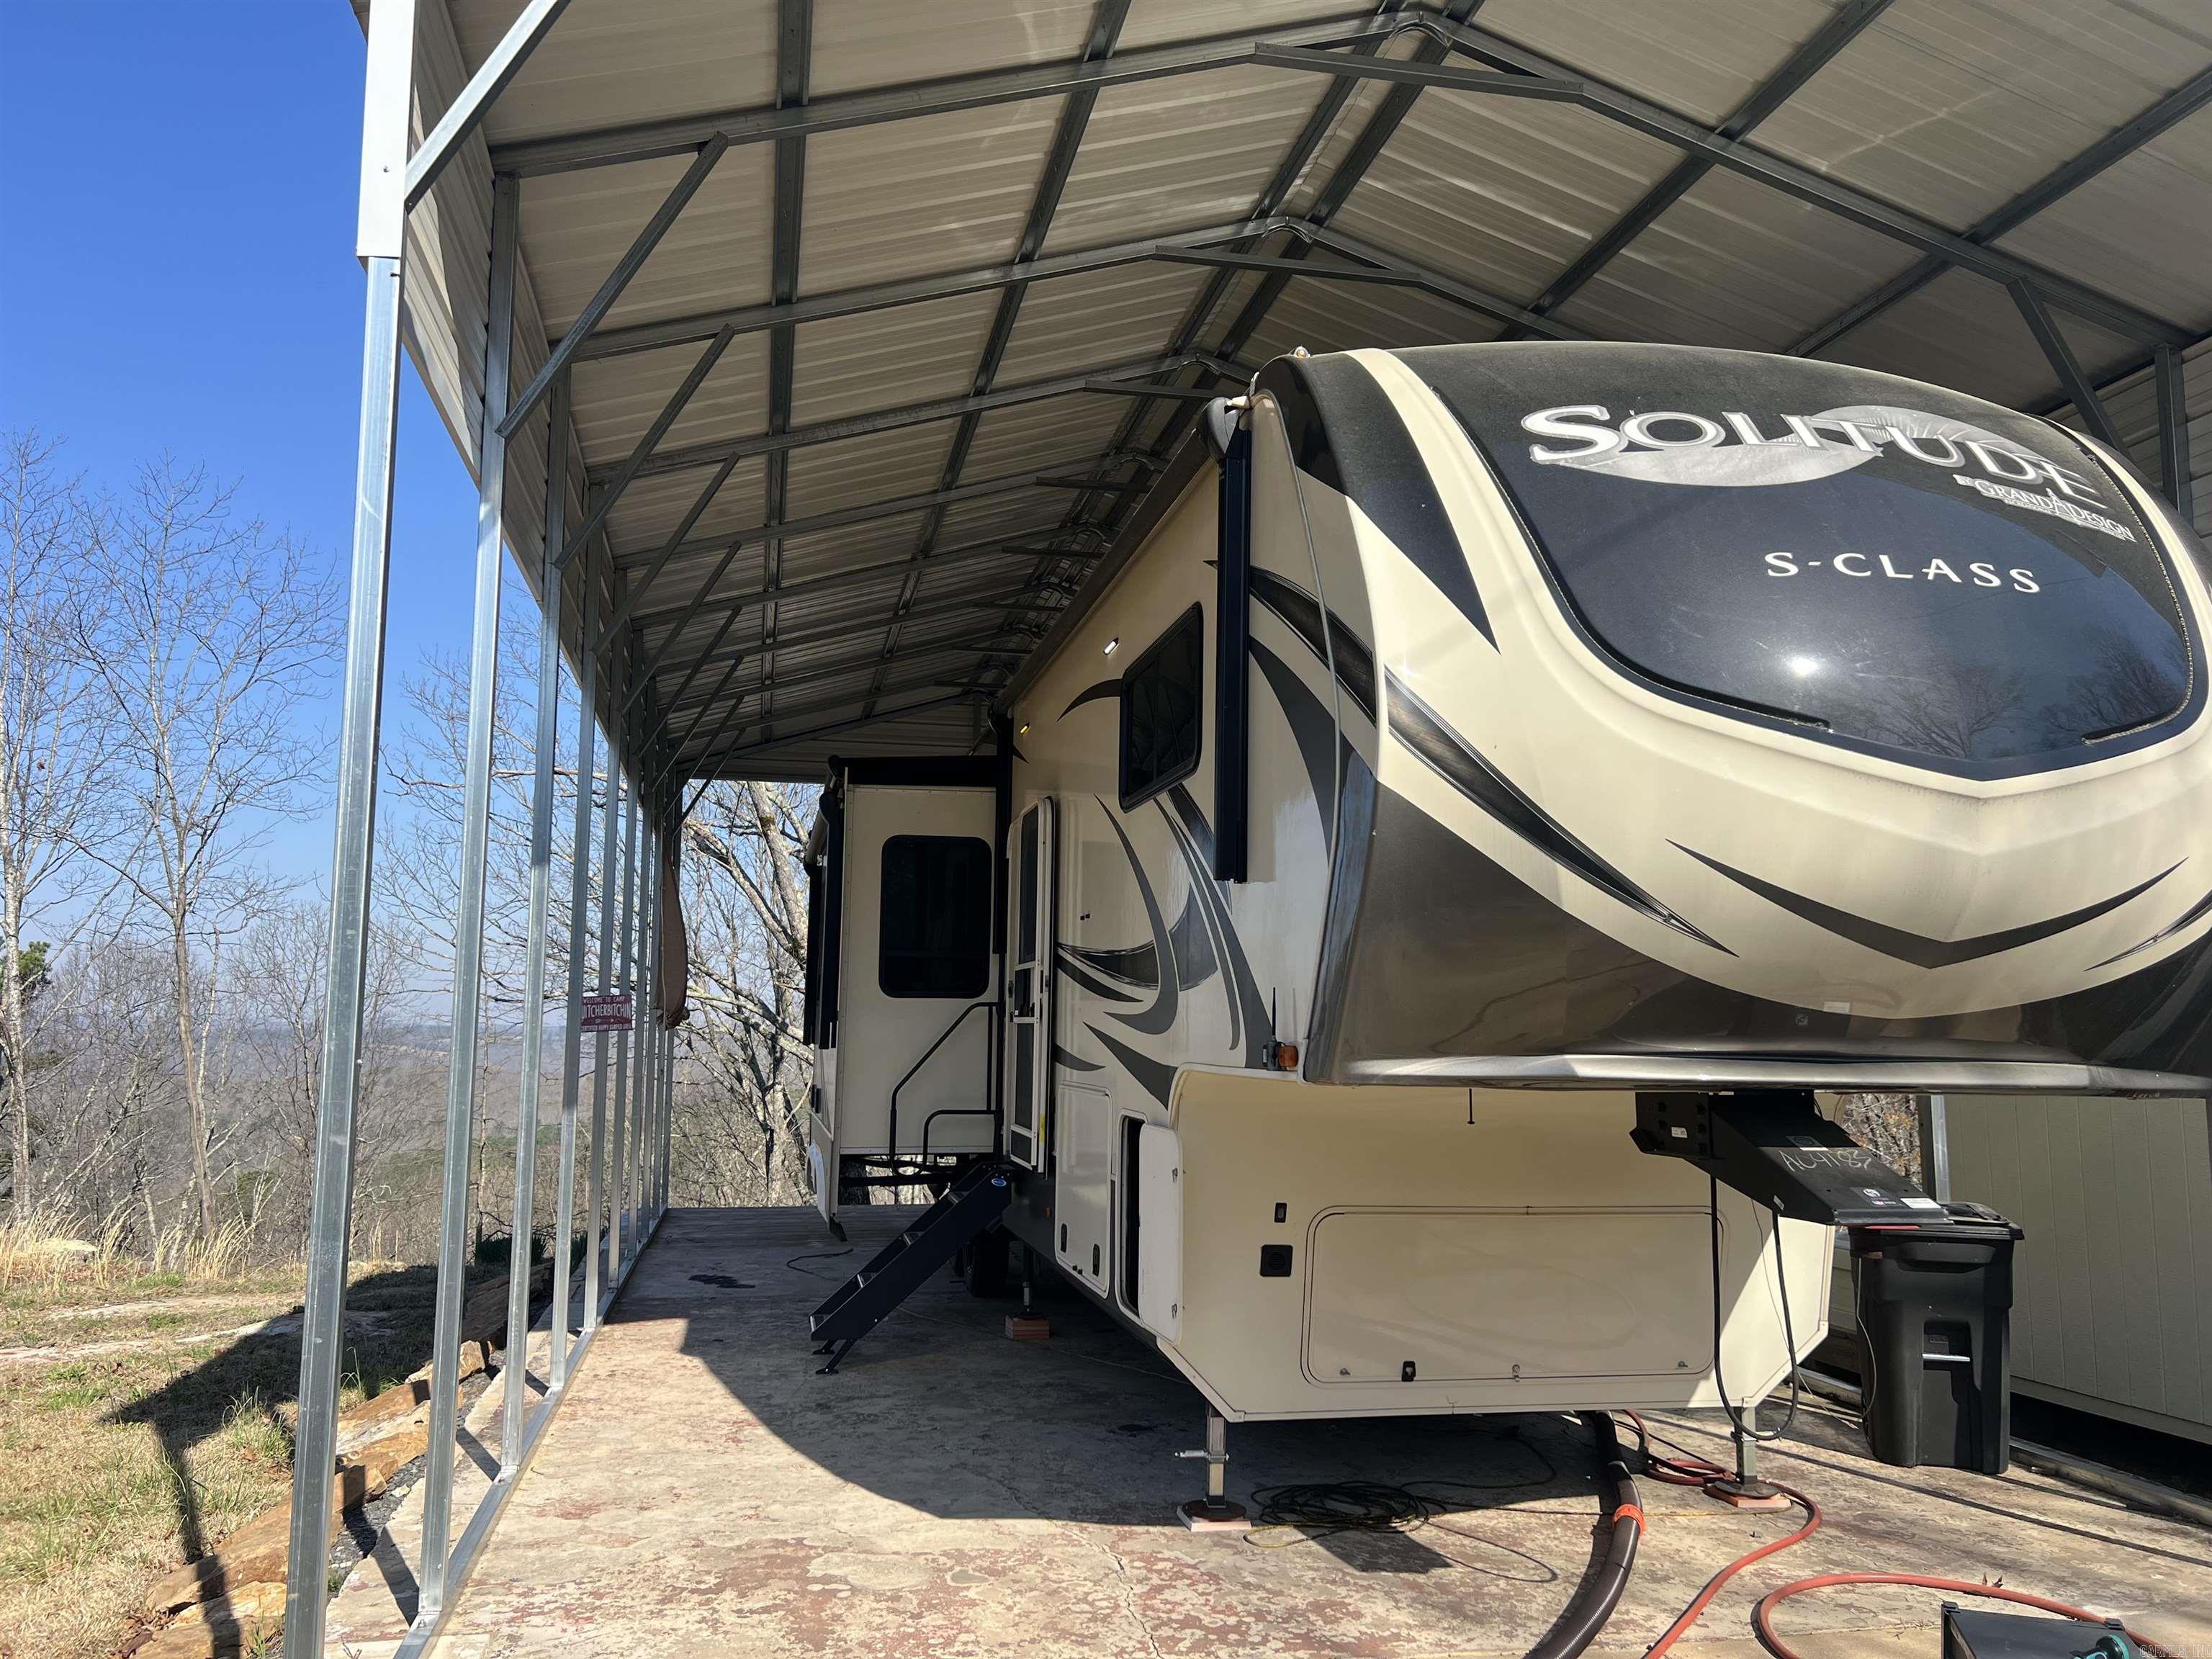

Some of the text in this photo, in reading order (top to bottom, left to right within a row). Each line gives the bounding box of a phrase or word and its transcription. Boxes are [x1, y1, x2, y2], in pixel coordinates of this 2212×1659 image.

[1521, 404, 2108, 510] SOLITUDE
[1974, 480, 2054, 509] GRAND
[2064, 503, 2136, 540] DESIGN
[1764, 552, 2041, 594] S-CLASS
[582, 1003, 631, 1019] UITCHERBITCHIN
